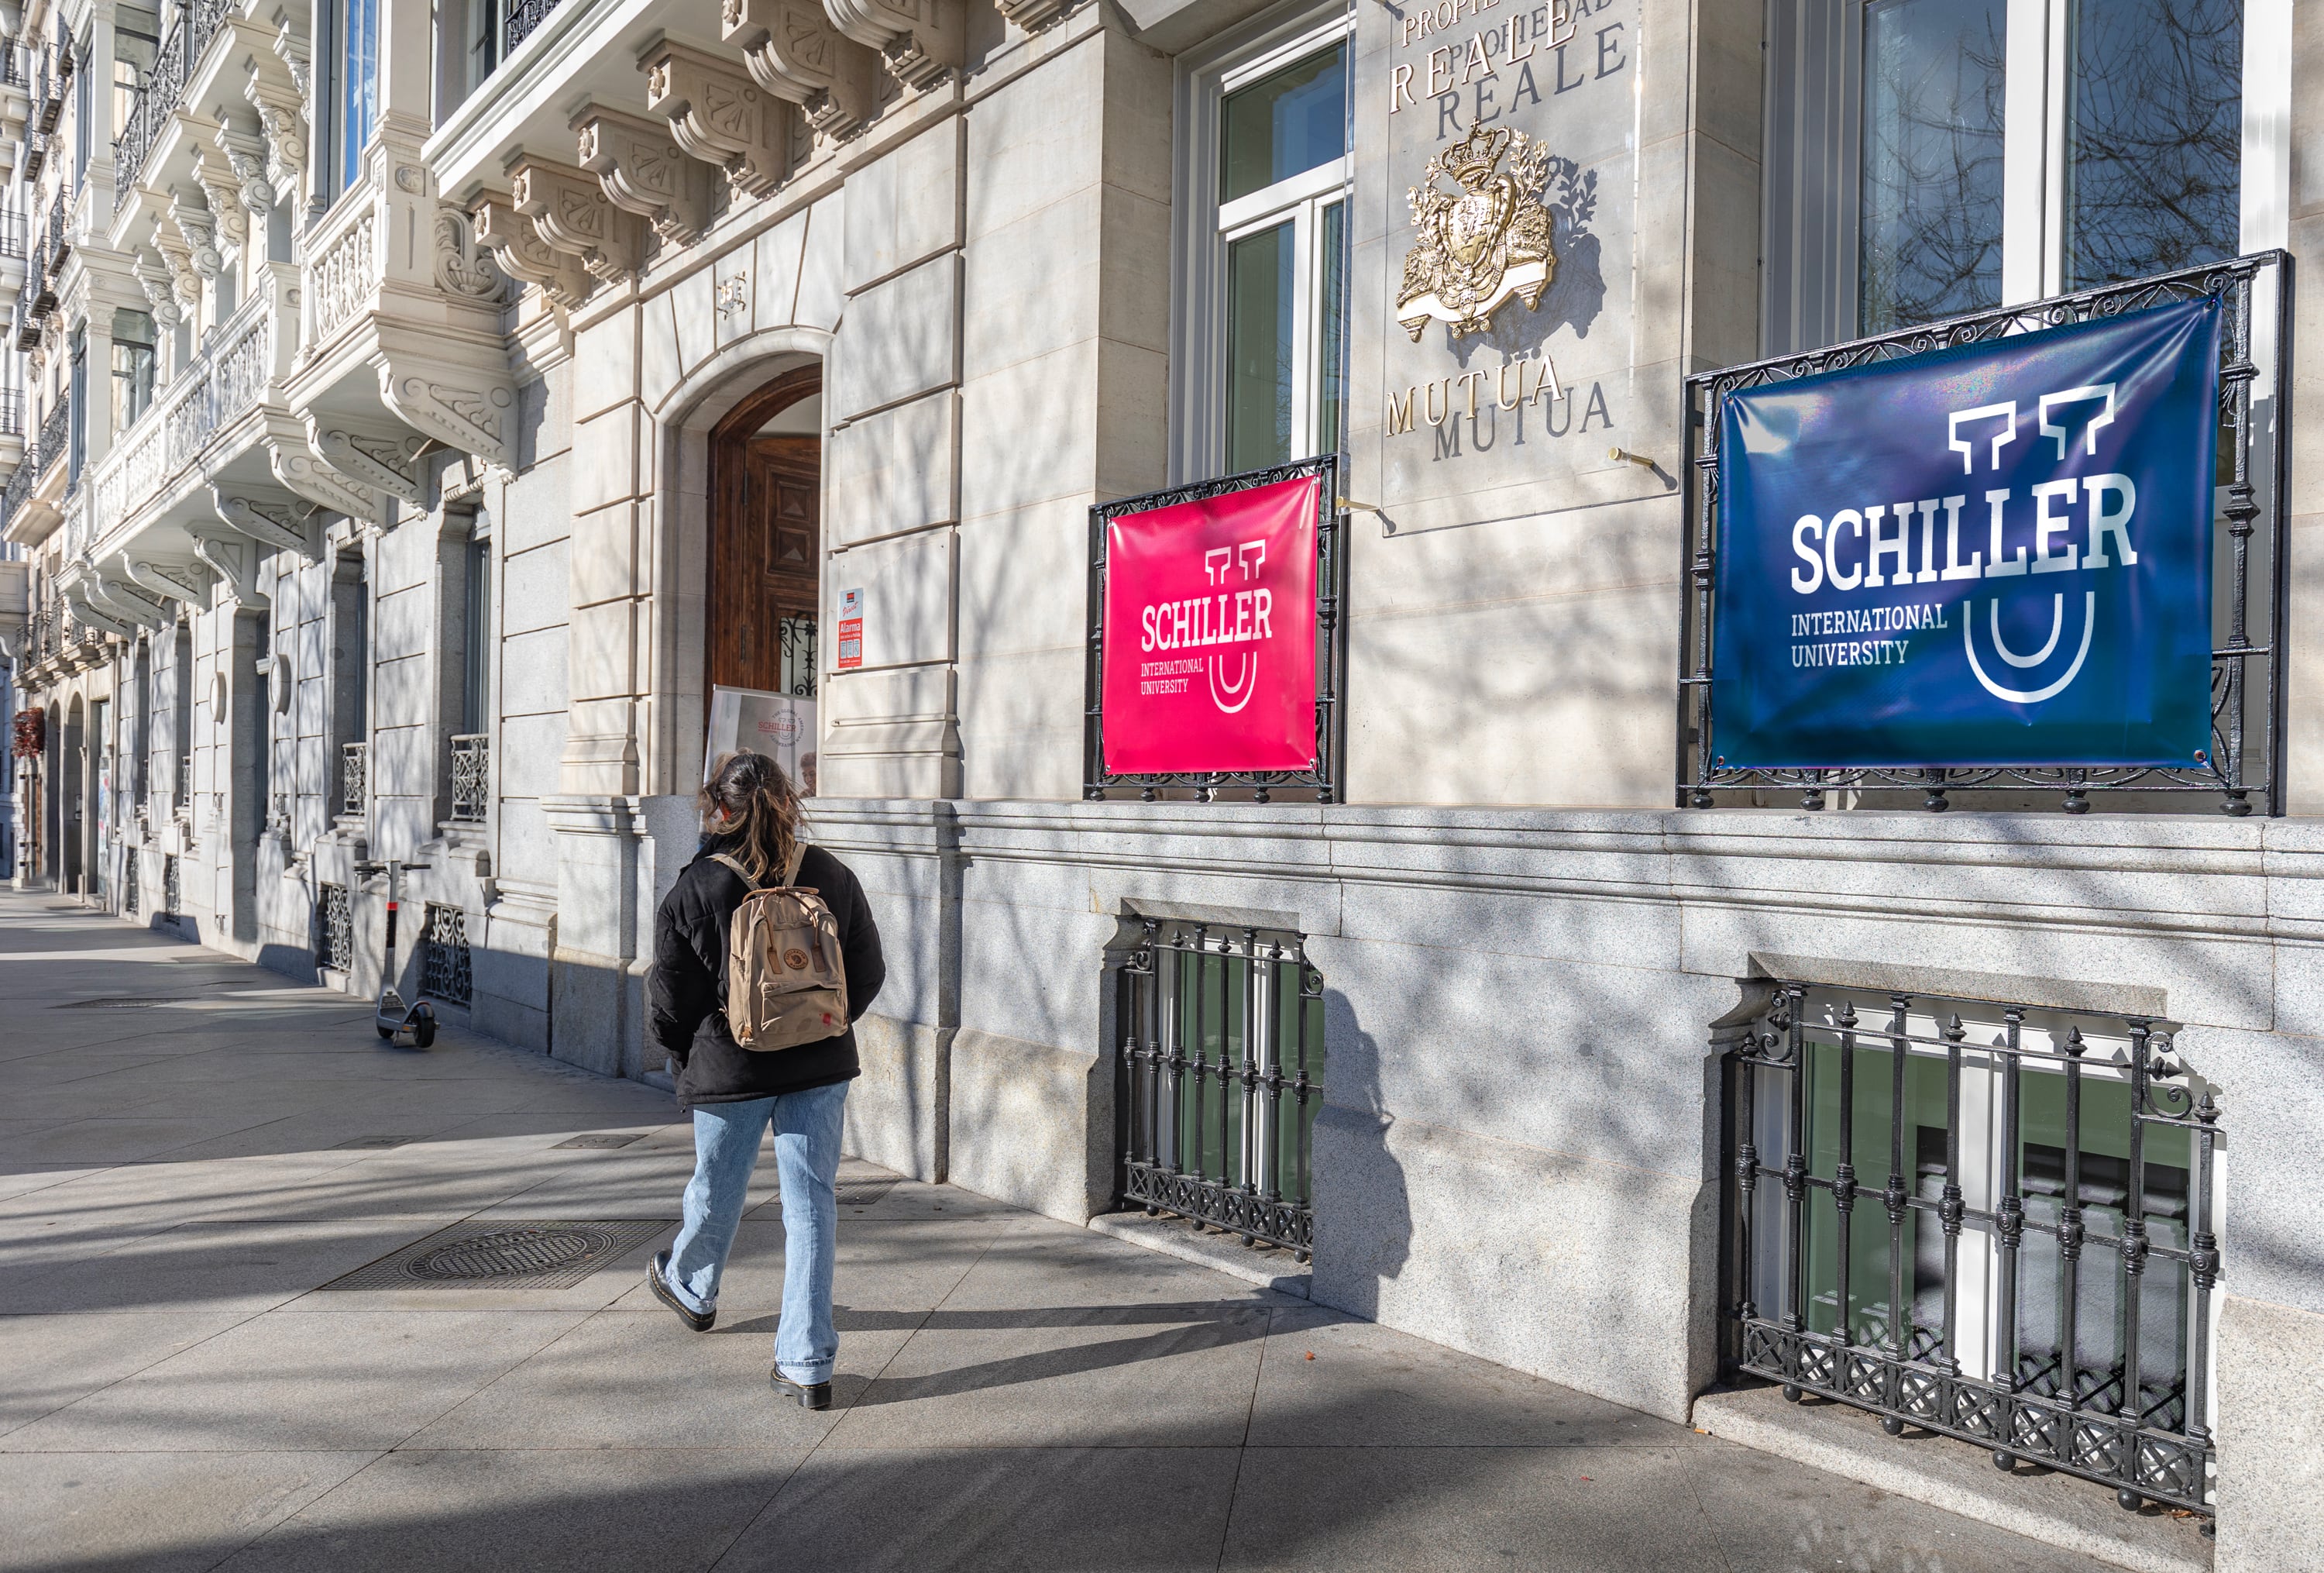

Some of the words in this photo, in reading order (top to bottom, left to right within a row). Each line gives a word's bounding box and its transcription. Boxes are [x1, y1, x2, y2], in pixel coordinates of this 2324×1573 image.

[1390, 0, 1577, 114] REALE
[1386, 354, 1565, 437] MUTUA
[1791, 473, 2138, 595] SCHILLER
[840, 621, 861, 633] Alarma
[1141, 587, 1272, 652] SCHILLER
[1791, 603, 1948, 637] INTERNATIONAL
[1140, 657, 1204, 677] INTERNATIONAL
[1791, 640, 1910, 668] UNIVERSITY
[1140, 677, 1189, 695] UNIVERSITY
[758, 721, 796, 732] SCHILLER
